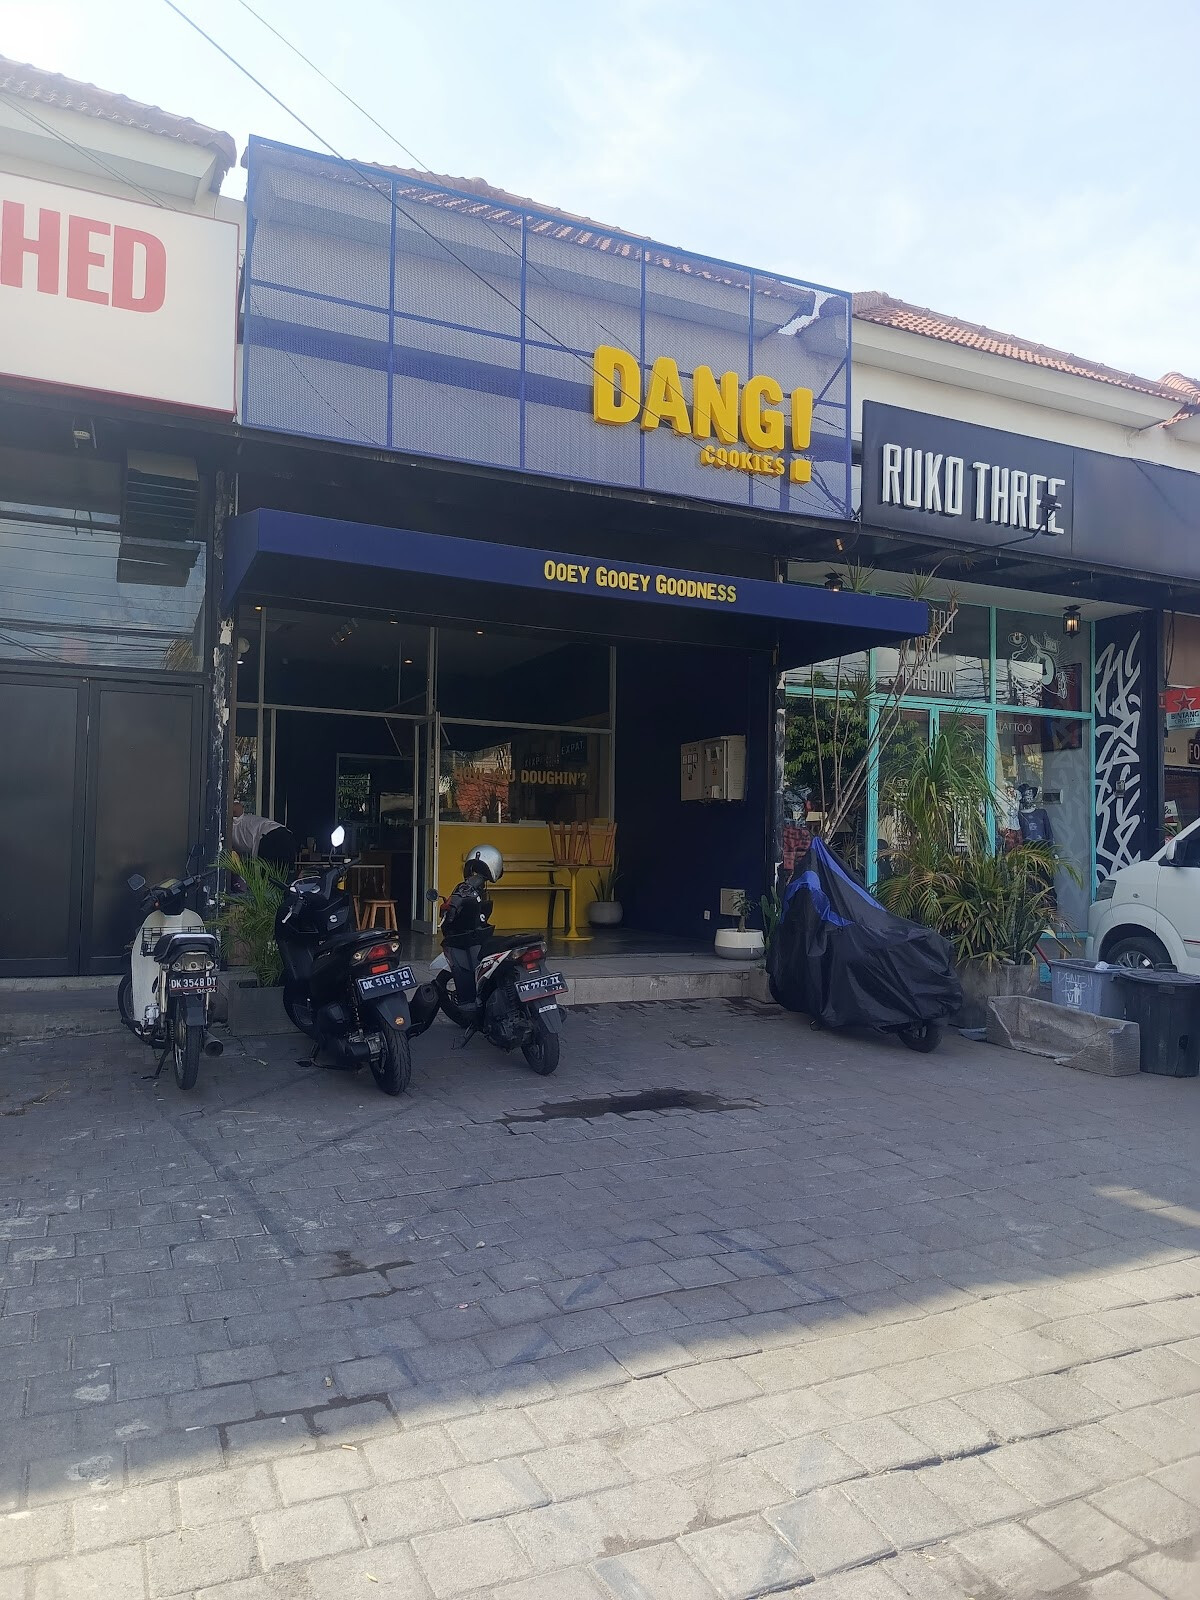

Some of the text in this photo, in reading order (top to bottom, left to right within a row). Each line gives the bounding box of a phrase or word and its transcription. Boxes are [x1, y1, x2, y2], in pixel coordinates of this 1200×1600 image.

[0, 199, 167, 314] HED
[593, 344, 814, 484] DANG!
[700, 445, 785, 477] COOKIES
[882, 443, 1066, 534] RUKO THREE
[544, 560, 737, 603] OOEY GOOEY GOODNESS
[521, 769, 587, 786] DOUGHIN'?
[171, 976, 217, 989] DK 3548 DY
[362, 980, 375, 990] DK
[375, 974, 396, 987] 5166
